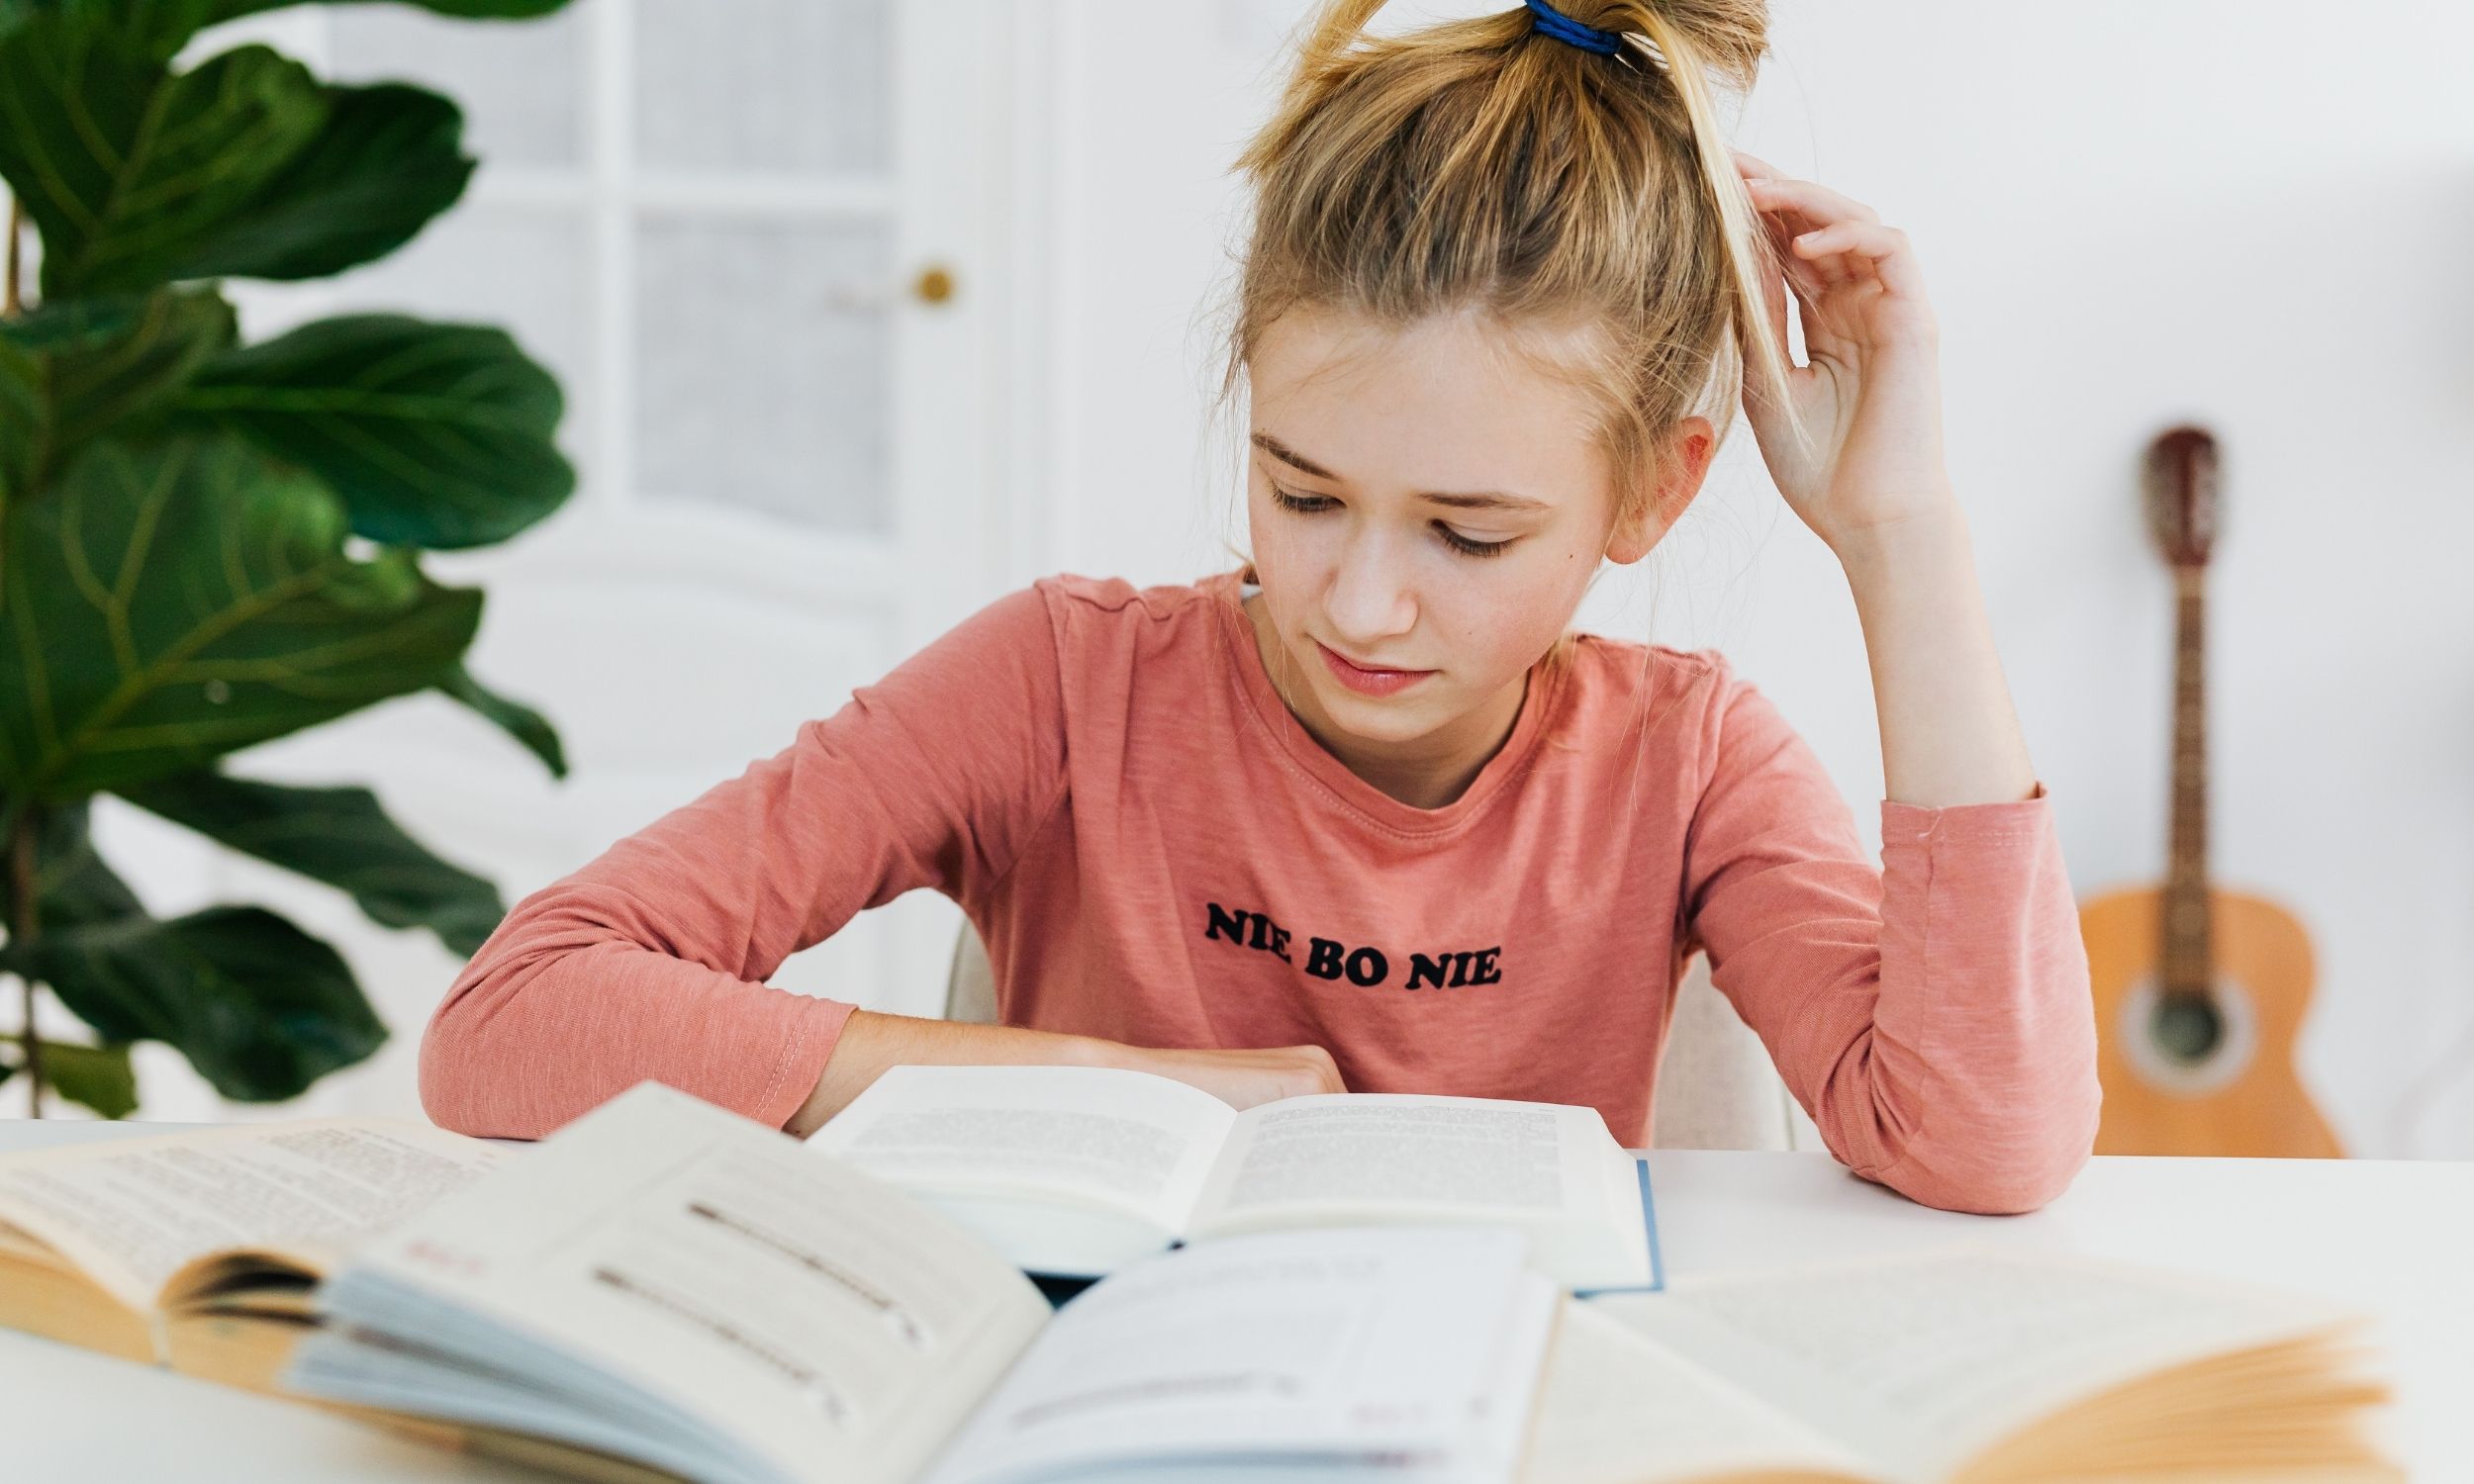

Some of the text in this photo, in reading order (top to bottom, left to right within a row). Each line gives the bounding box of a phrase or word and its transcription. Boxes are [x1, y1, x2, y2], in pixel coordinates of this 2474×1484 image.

[1205, 902, 1502, 990] NIE BO NIE
